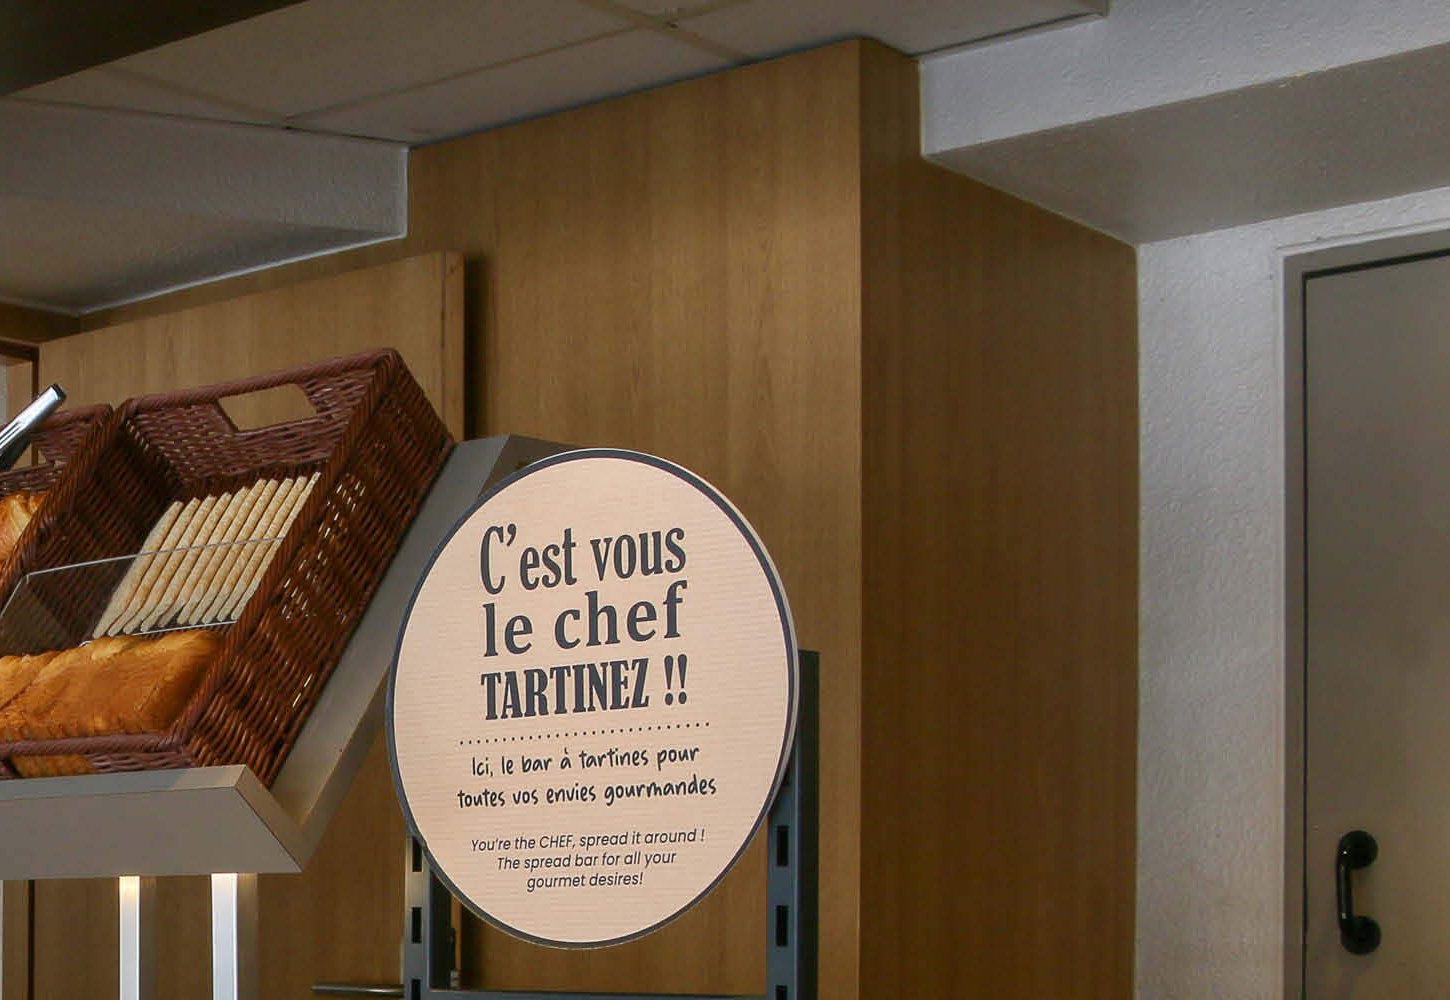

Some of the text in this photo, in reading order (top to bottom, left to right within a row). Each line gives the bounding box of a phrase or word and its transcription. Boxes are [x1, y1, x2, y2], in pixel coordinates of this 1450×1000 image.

[481, 523, 688, 595] C'est vous
[482, 580, 688, 658] le chef
[480, 653, 688, 721] TARTINEZ !!
[472, 746, 701, 777] Ici, le bar à tartines pour
[457, 774, 718, 808] toutes vos envies gourmandes
[471, 838, 511, 852] You're
[515, 836, 536, 849] the
[539, 834, 576, 849] CHEF,
[579, 832, 629, 850] spread
[631, 831, 641, 845] it
[644, 828, 697, 844] around
[497, 851, 677, 872] The spread bar for all your
[526, 872, 644, 893] gourmet desires!
